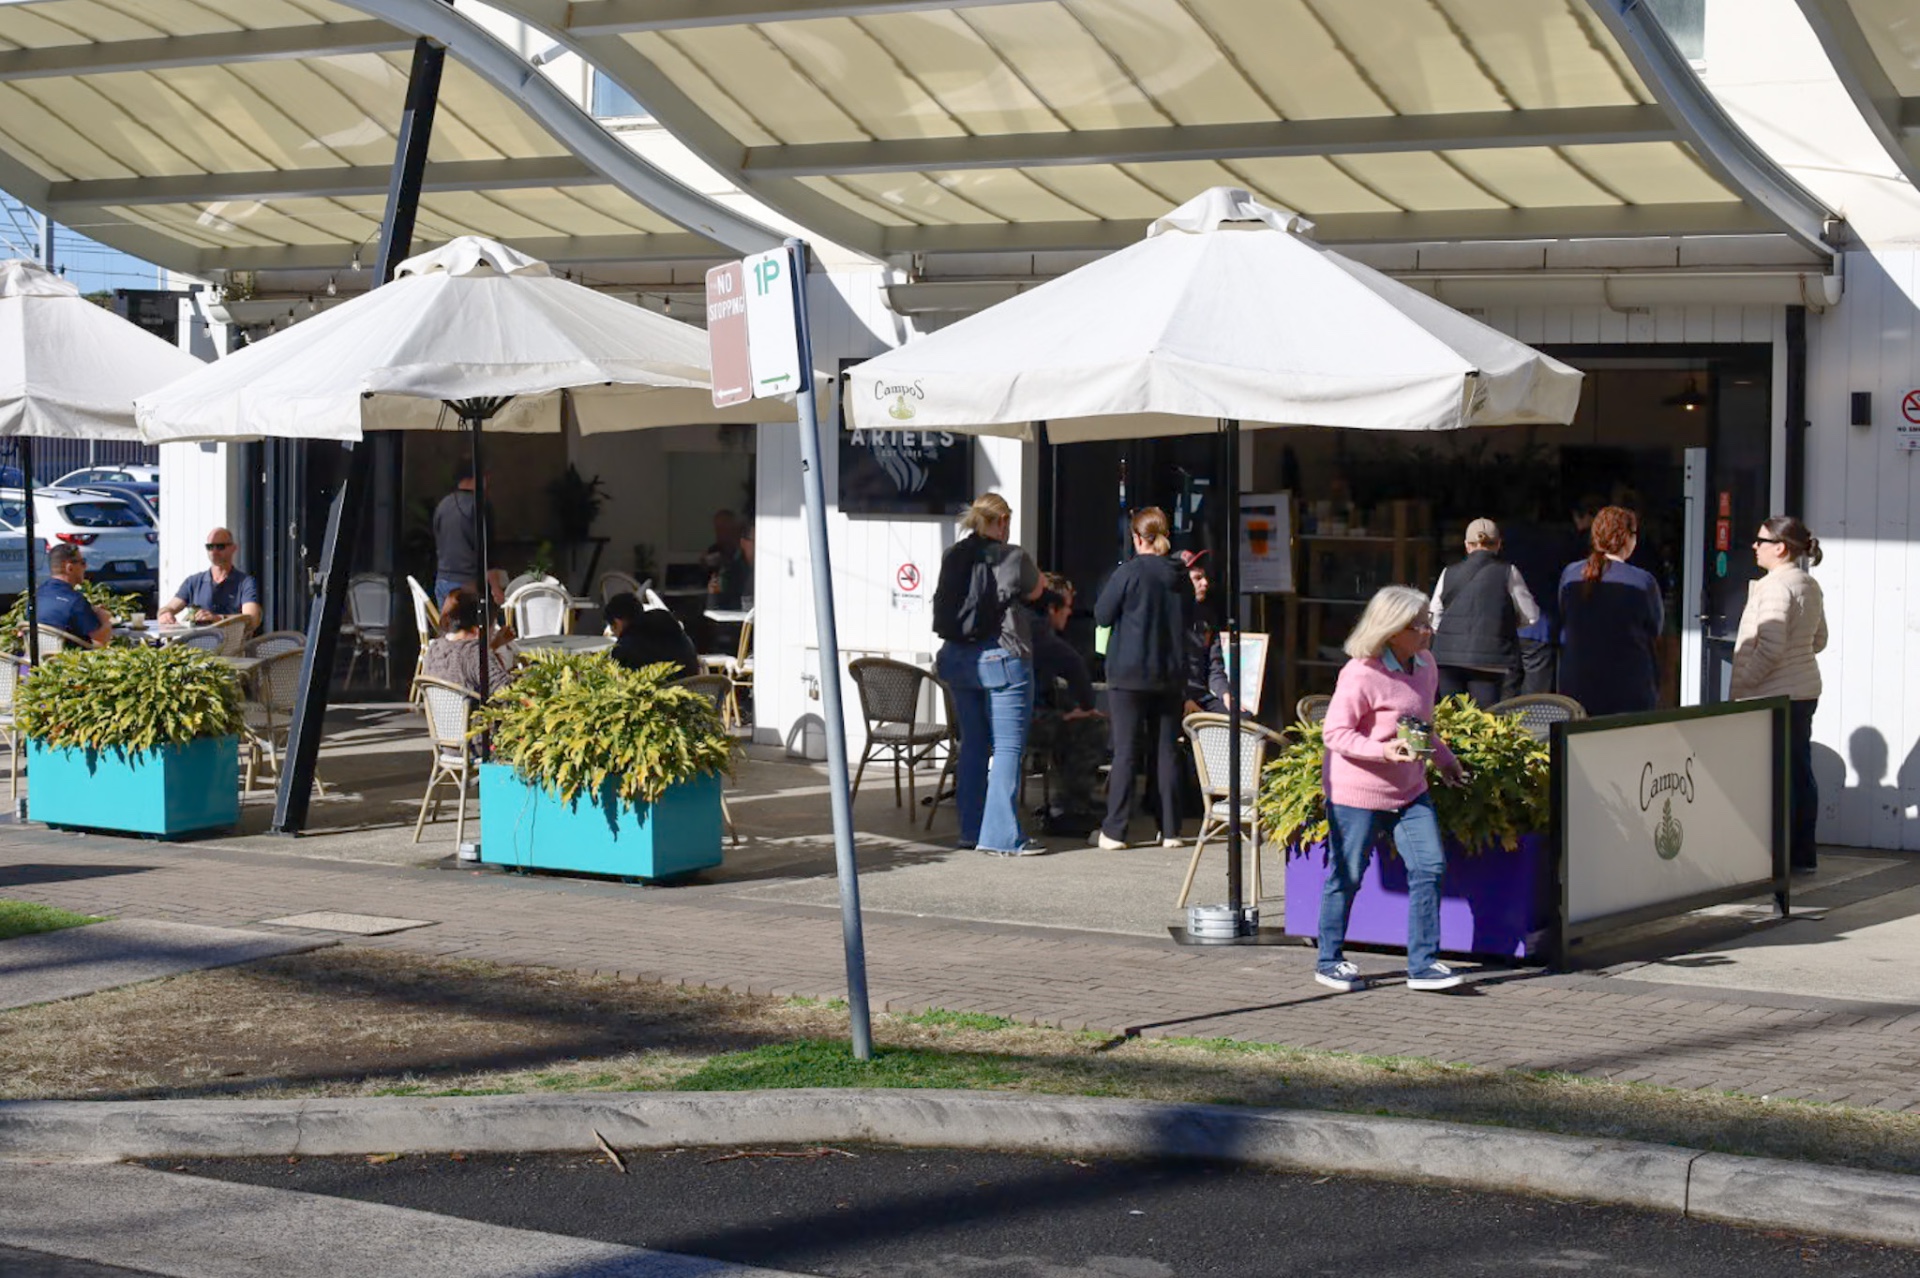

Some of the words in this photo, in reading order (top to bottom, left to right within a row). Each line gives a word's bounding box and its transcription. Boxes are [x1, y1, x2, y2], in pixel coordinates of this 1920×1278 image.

[717, 273, 732, 295] NO
[754, 260, 780, 296] 1P
[709, 296, 745, 321] STOPPING
[851, 429, 954, 447] ARIELS
